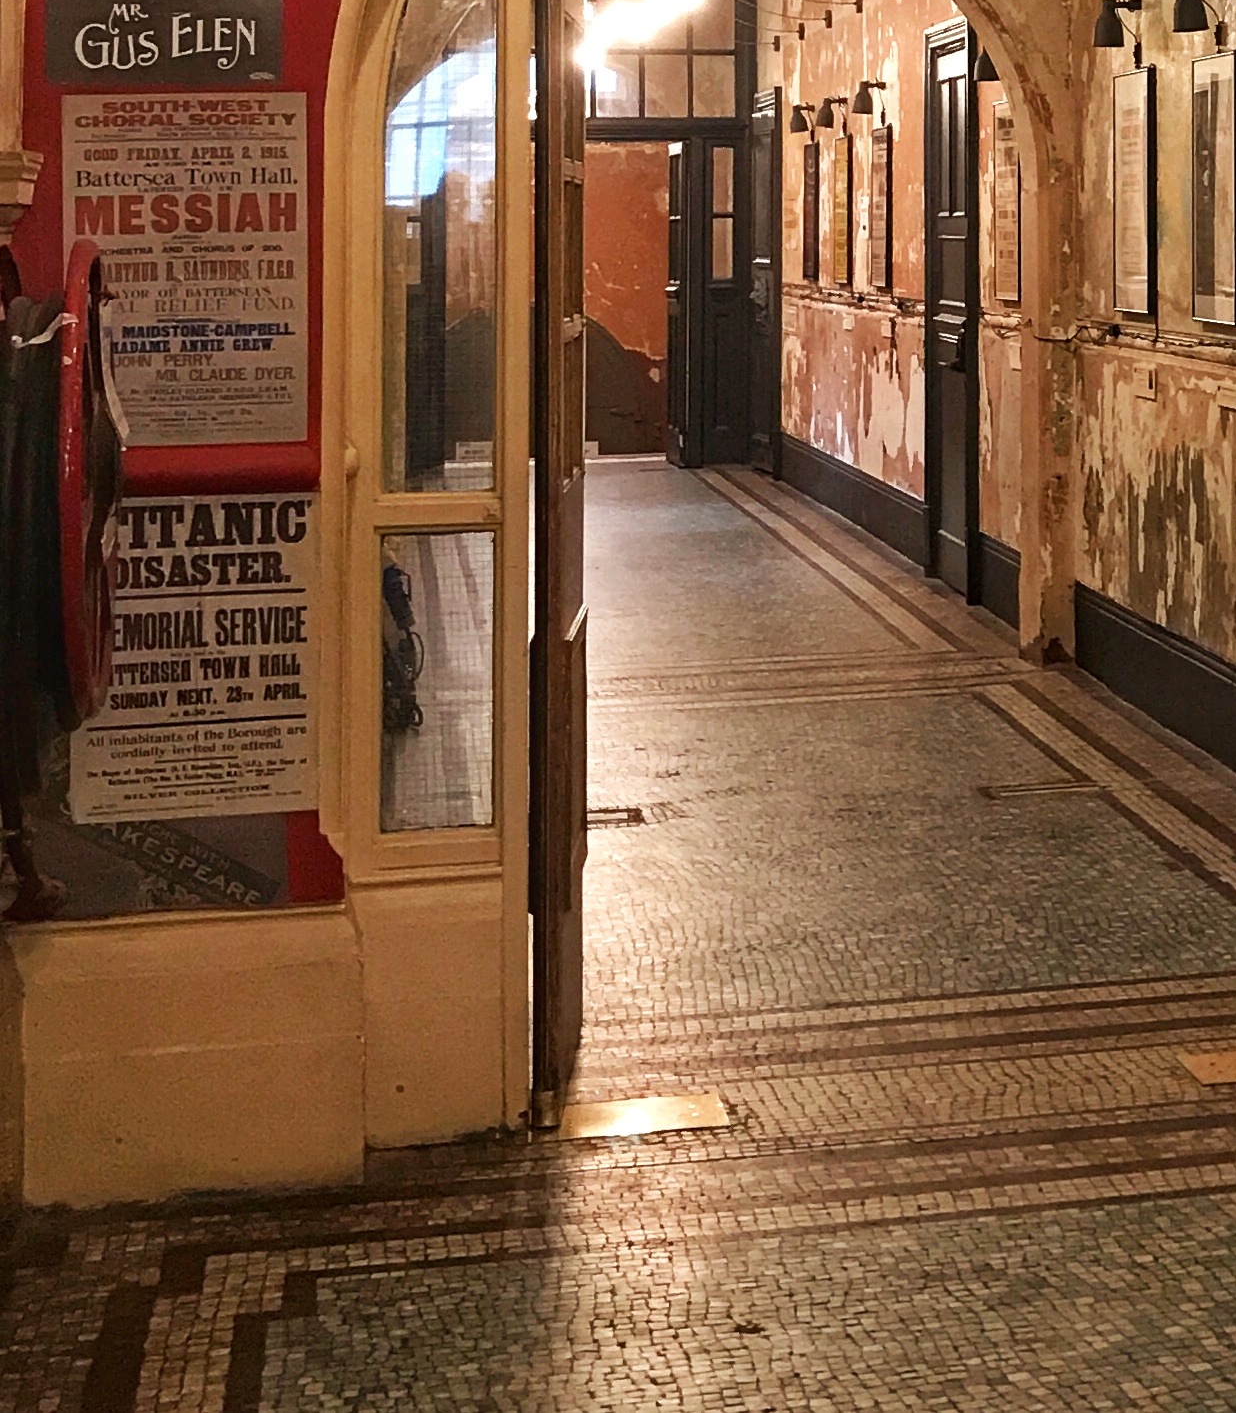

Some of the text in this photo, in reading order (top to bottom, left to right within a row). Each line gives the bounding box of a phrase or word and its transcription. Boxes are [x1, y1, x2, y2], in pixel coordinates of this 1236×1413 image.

[171, 12, 257, 70] ELEN
[74, 112, 298, 129] CHORAL SOCIETY
[75, 167, 299, 188] Battersea Town Hall,
[74, 191, 297, 236] MESSIAH
[113, 606, 308, 652] EMORIAL SERVICE
[111, 653, 301, 686] TTERSEA TOWN HALL
[110, 690, 168, 710] SUNDAY
